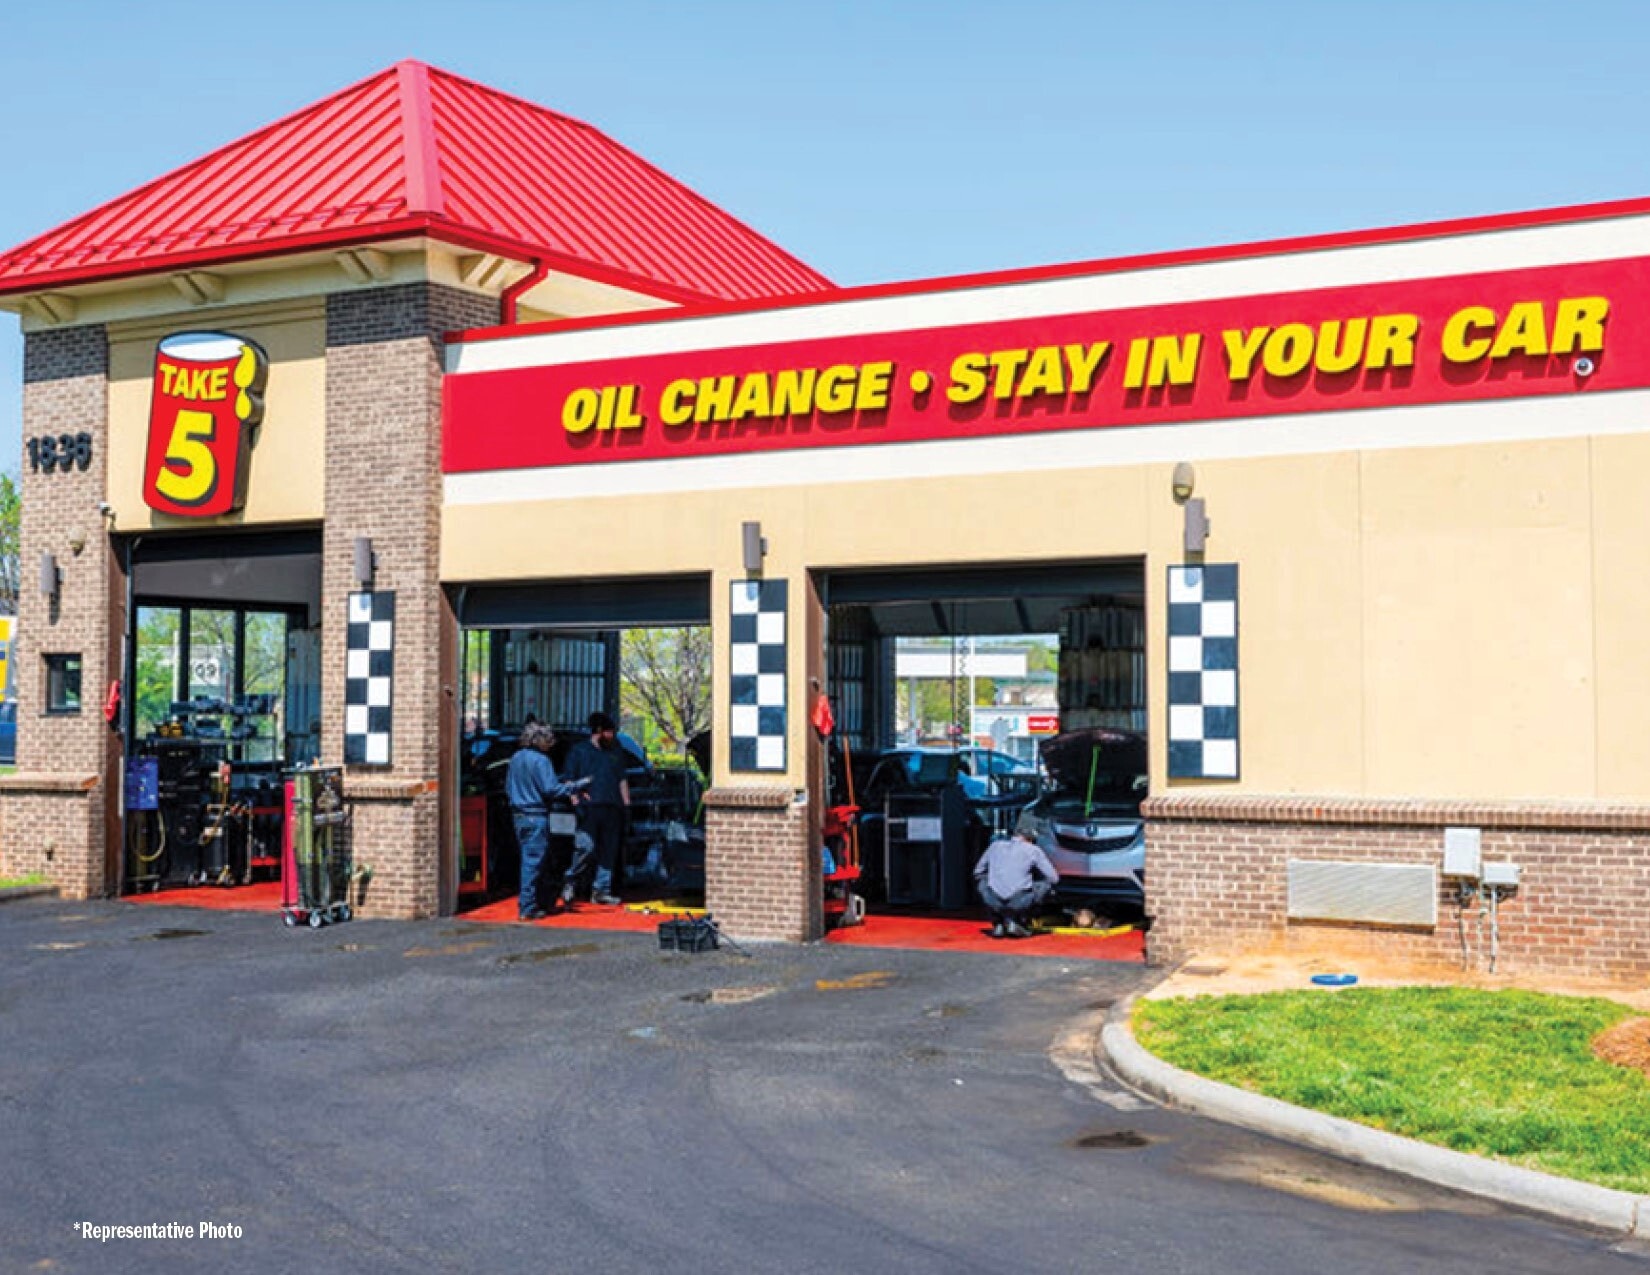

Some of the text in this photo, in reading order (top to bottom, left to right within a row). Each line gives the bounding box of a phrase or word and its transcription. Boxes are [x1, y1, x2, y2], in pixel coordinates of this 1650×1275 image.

[159, 363, 229, 400] TAKE
[561, 297, 1609, 433] OIL CHANGE STAY IN YOUR CAR
[155, 409, 216, 502] 5
